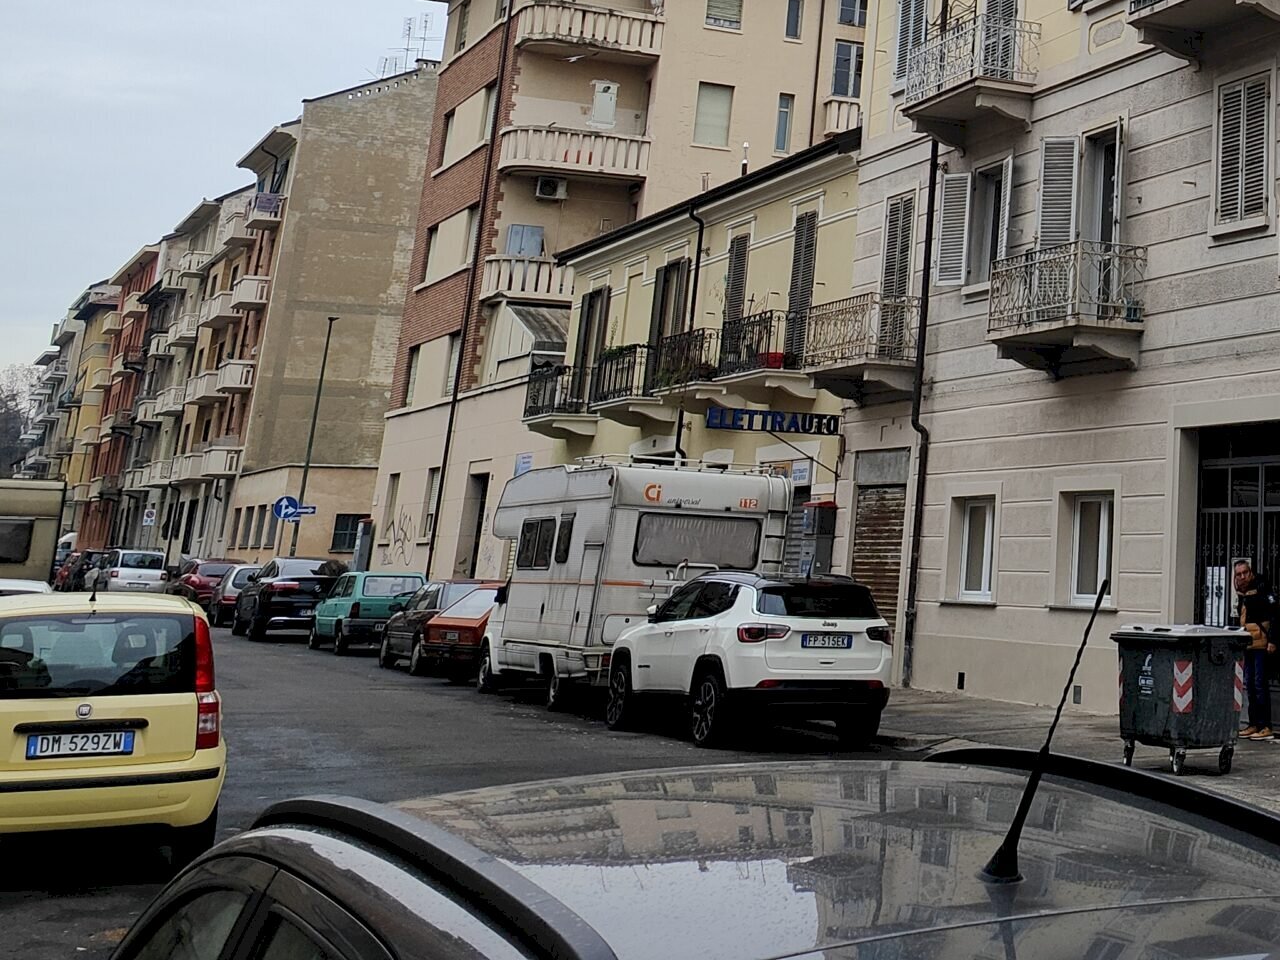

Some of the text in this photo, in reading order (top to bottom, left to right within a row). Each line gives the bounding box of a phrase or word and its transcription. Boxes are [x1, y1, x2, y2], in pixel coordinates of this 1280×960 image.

[707, 407, 839, 434] ELETTRAUTO
[740, 498, 758, 508] 112
[40, 735, 62, 754] DM
[68, 733, 123, 752] 529ZW
